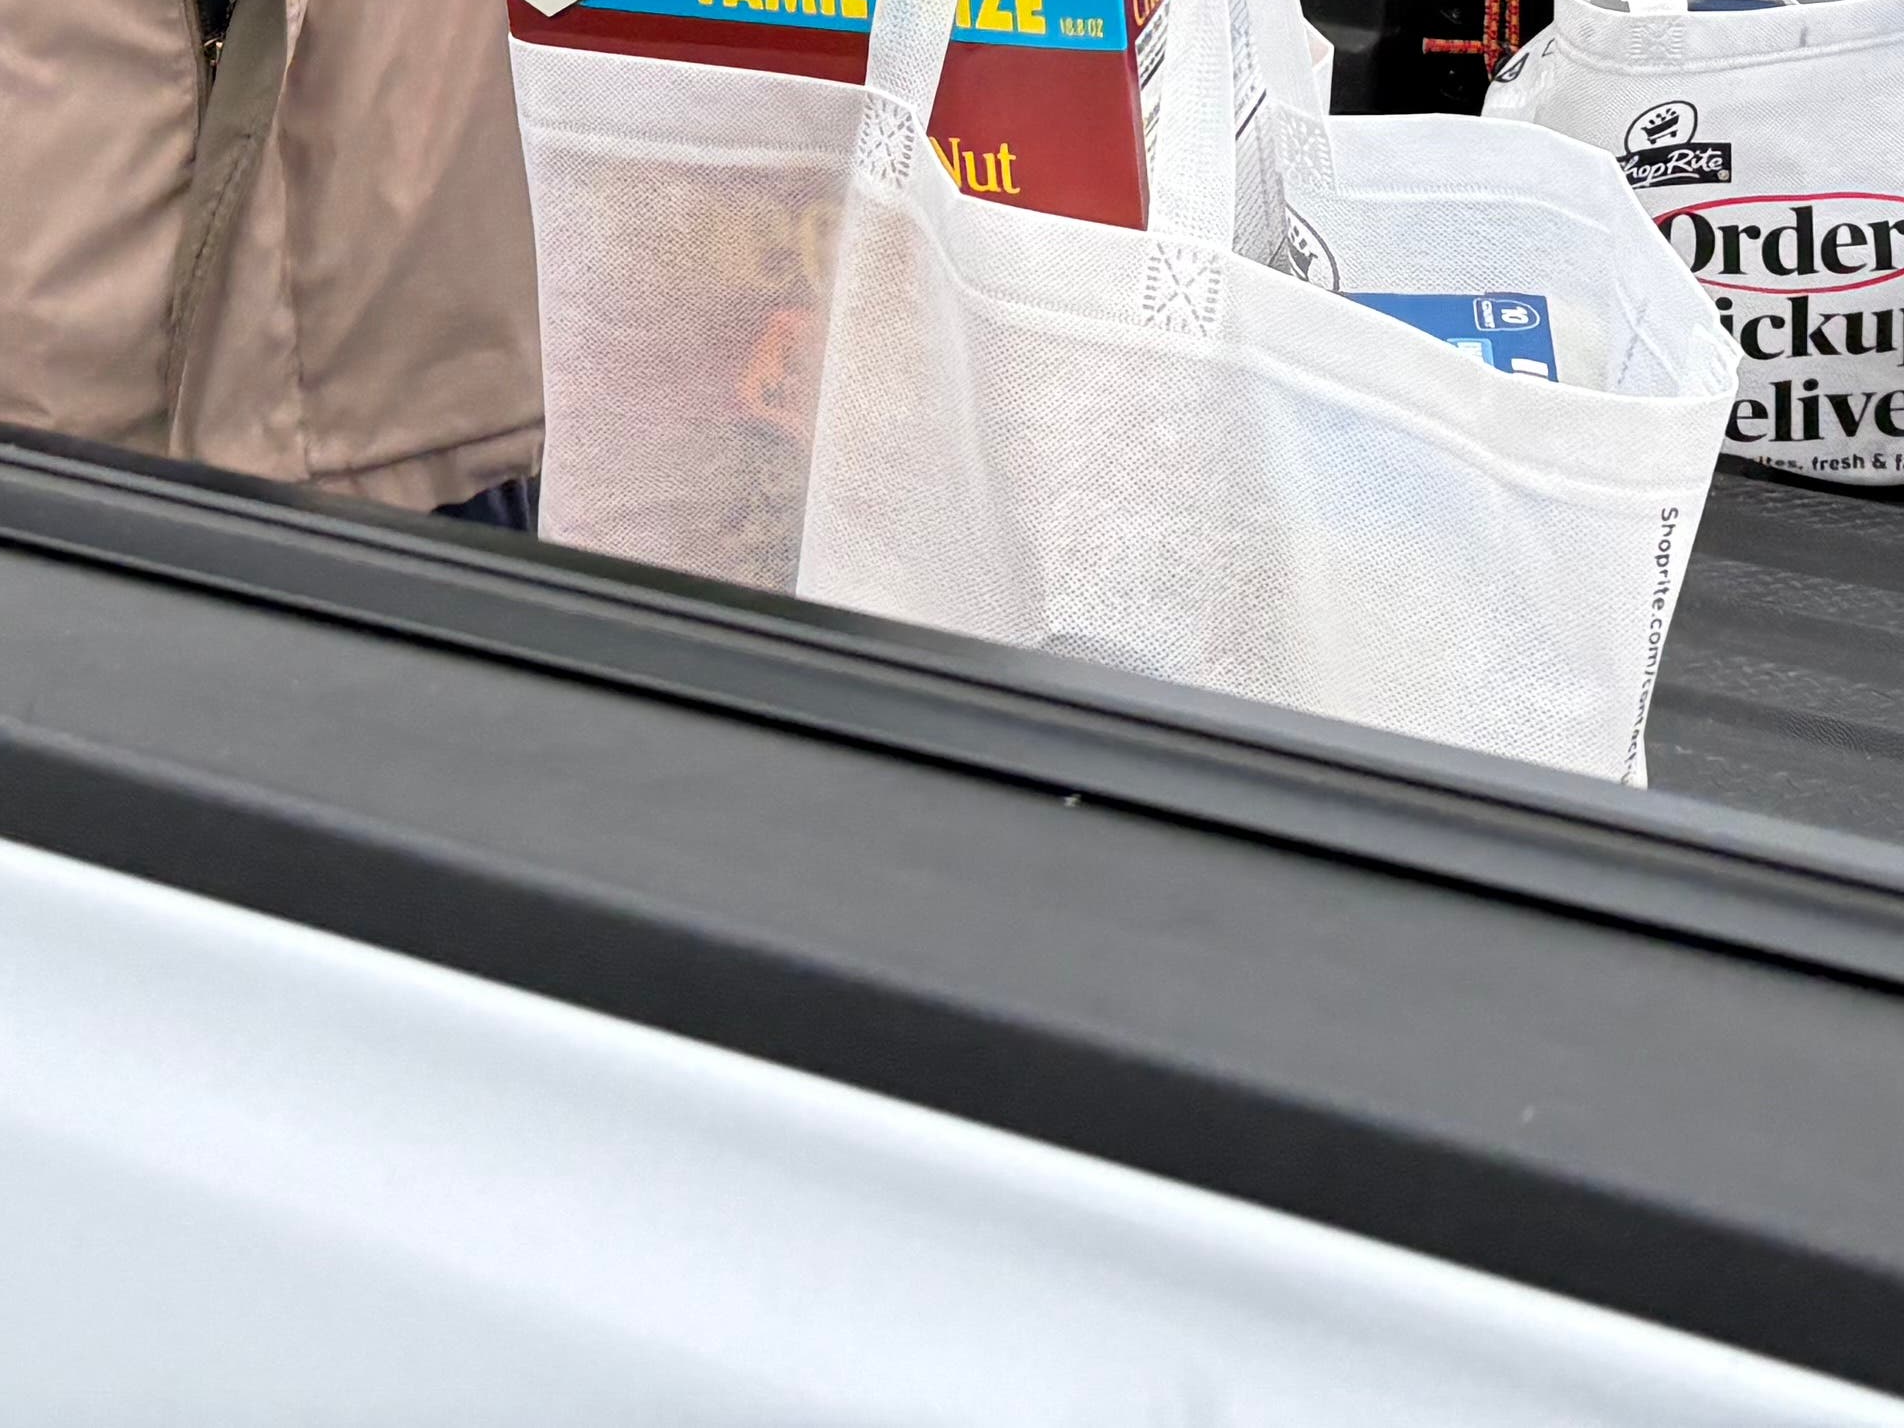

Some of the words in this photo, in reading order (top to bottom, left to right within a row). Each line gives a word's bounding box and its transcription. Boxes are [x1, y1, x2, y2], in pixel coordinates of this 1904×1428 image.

[930, 137, 1021, 194] Nut
[1812, 454, 1865, 471] fresh
[1872, 452, 1888, 470] &
